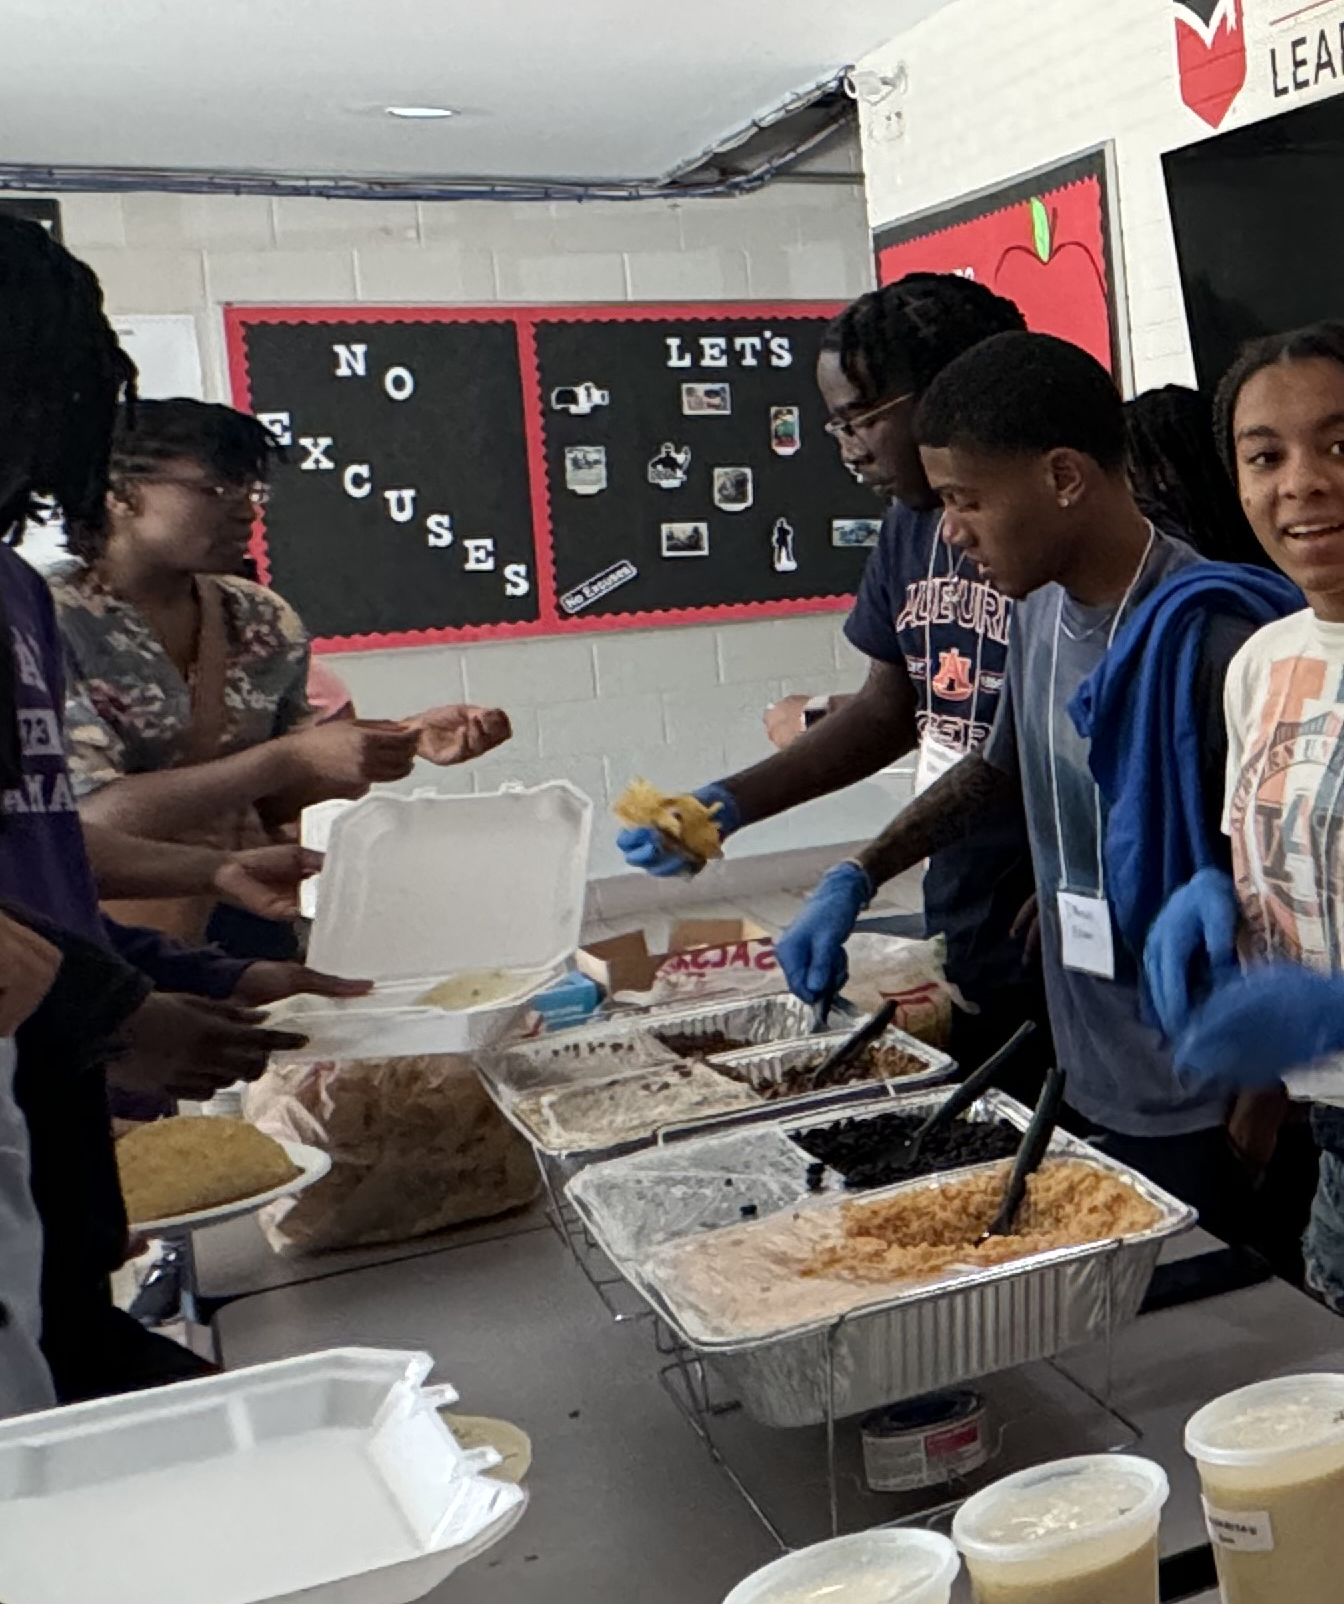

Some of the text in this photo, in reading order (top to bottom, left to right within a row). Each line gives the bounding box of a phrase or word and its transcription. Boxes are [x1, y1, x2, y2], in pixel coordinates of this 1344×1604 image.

[332, 343, 415, 401] NO
[665, 330, 793, 368] LET'S
[256, 411, 531, 597] EXCUSES
